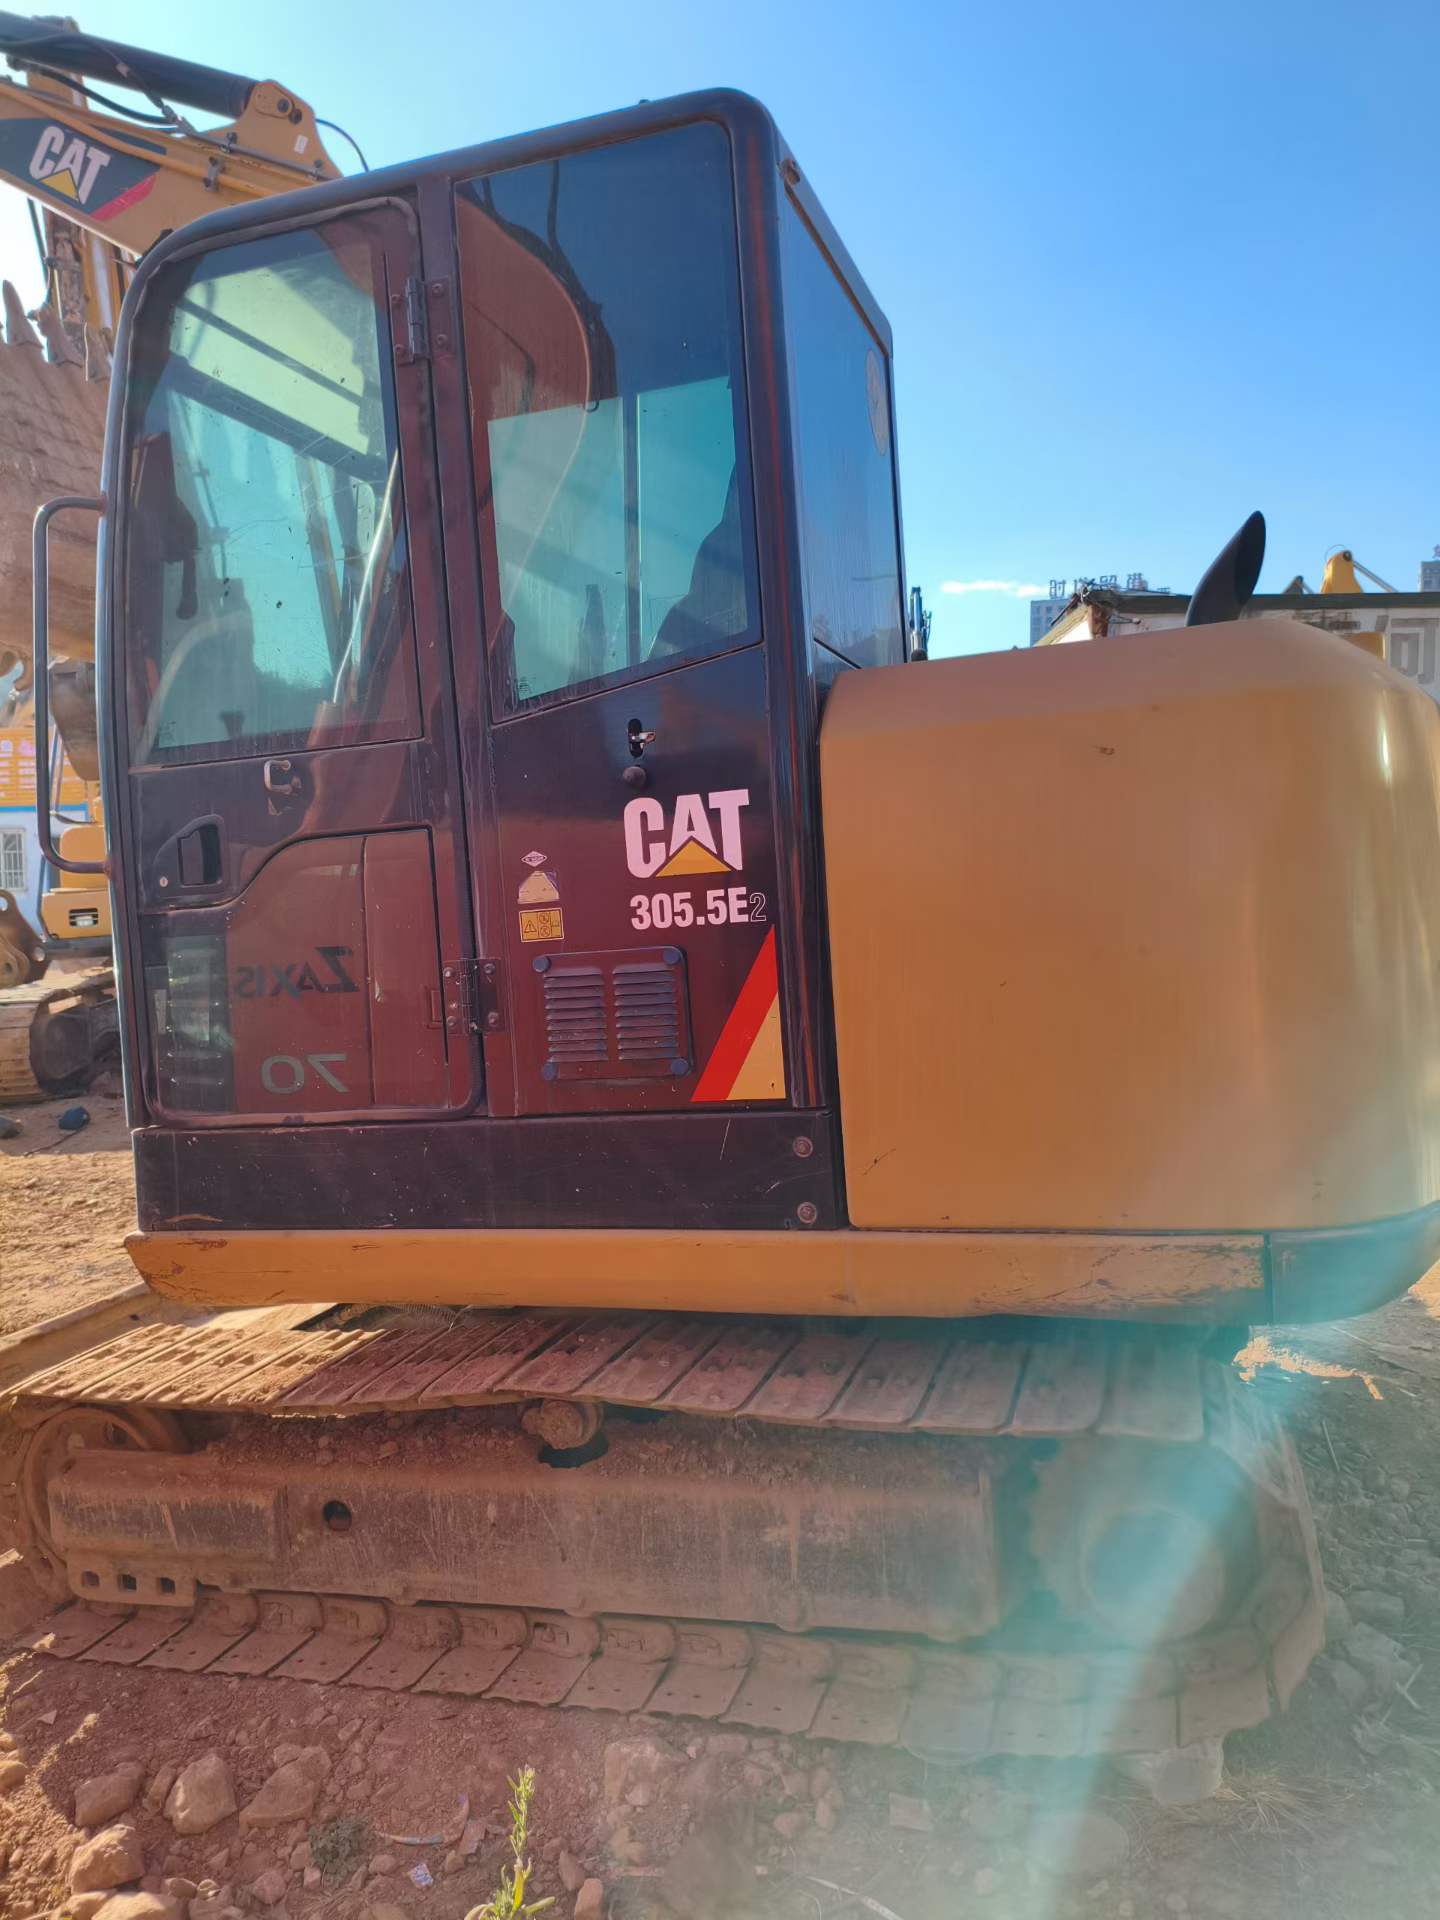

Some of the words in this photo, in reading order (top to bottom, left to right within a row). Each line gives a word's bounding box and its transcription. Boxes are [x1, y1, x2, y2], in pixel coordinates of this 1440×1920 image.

[29, 126, 112, 205] CAT
[623, 788, 750, 879] CAT
[629, 886, 767, 931] 305.5E2
